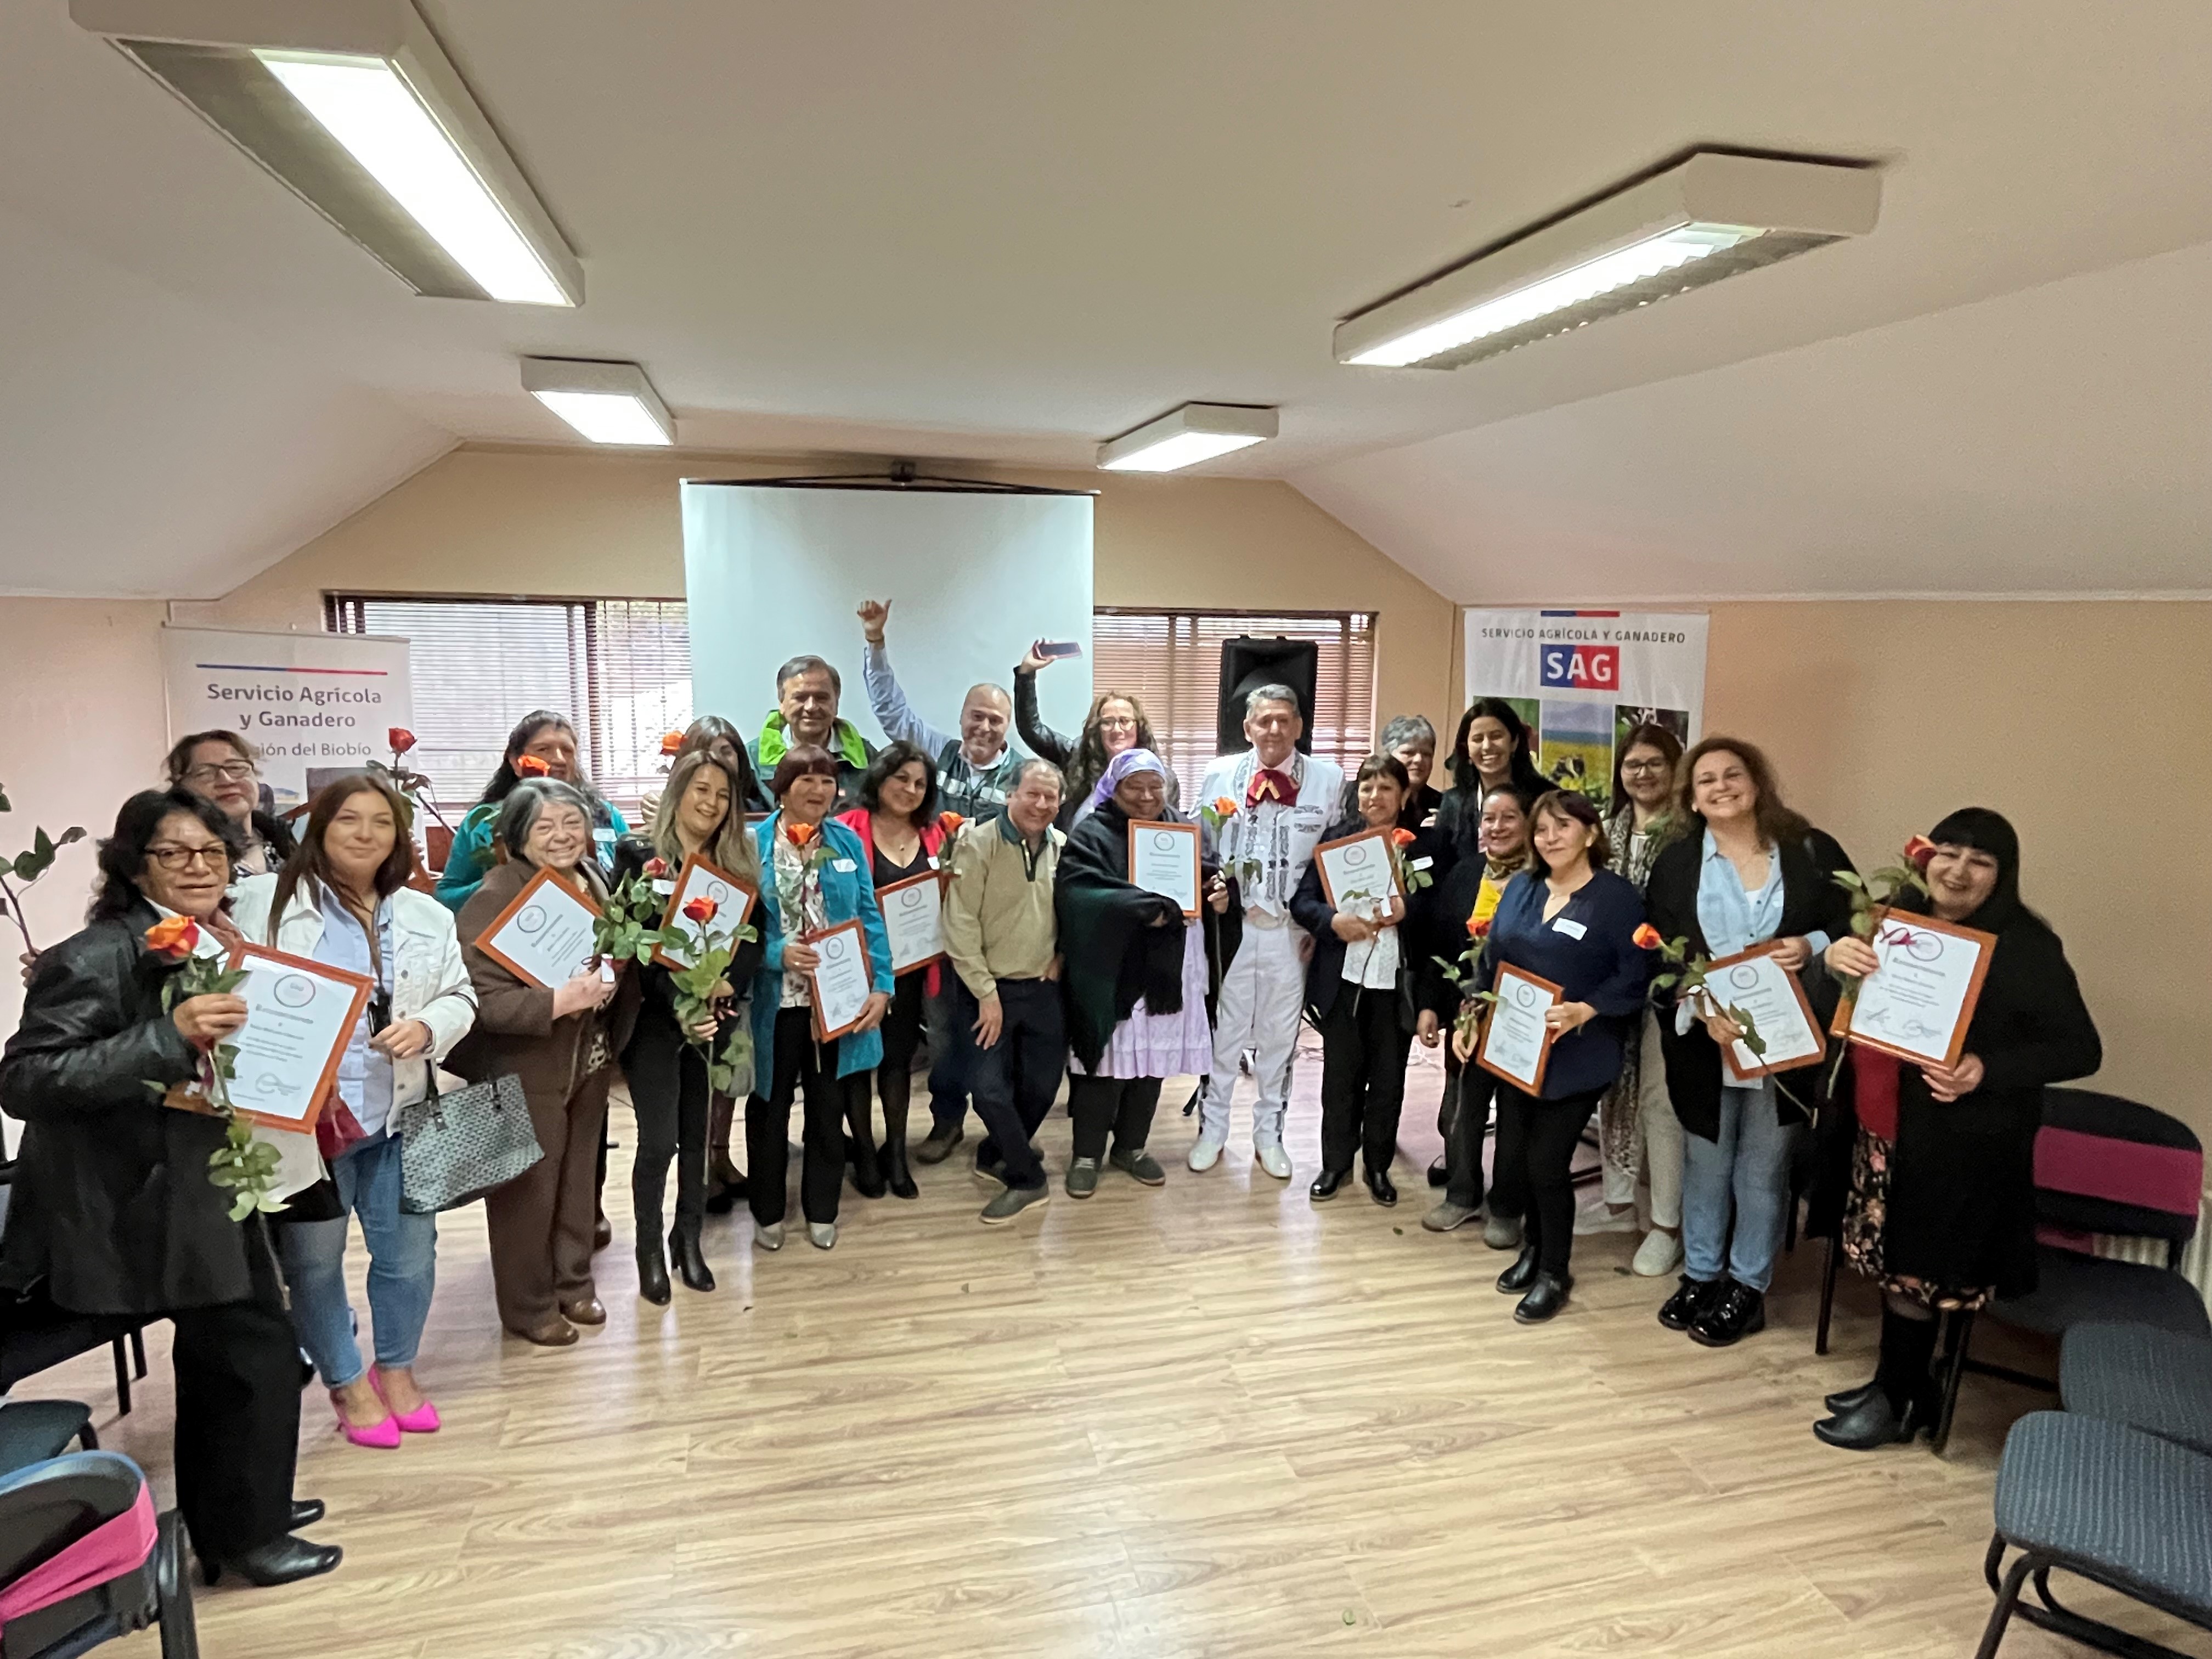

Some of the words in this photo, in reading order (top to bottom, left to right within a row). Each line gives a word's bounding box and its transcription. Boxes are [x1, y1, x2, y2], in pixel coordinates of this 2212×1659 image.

[1481, 627, 1535, 639] SERVICIO
[1538, 627, 1598, 641] AGRÍCOLA
[1602, 629, 1611, 641] Y
[1615, 630, 1686, 644] GANADERO
[1547, 651, 1612, 682] SAG
[207, 683, 294, 702] Servicio
[299, 686, 382, 707] Agrícola
[239, 714, 252, 731] y
[258, 711, 356, 727] Ganadero
[261, 742, 286, 756] ión
[291, 742, 316, 756] del
[321, 742, 371, 756] Biobío
